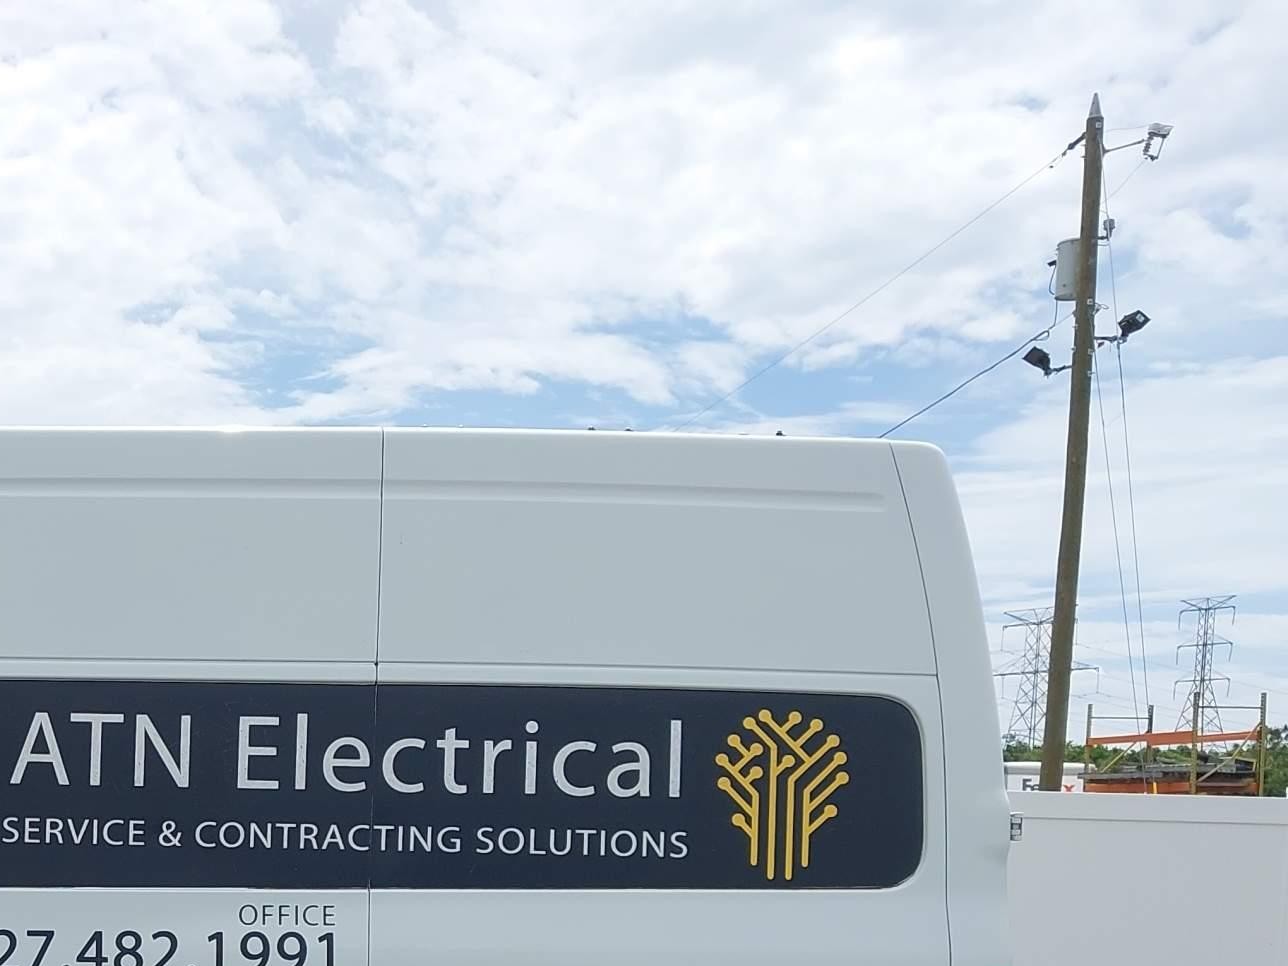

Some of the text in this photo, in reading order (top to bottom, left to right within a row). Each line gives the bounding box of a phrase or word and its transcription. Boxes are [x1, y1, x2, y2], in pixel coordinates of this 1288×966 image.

[10, 711, 682, 799] ATN Electrical
[2, 816, 688, 859] SERVICE & CONTRACTING SOLUTIONS
[238, 904, 337, 927] OFFICE
